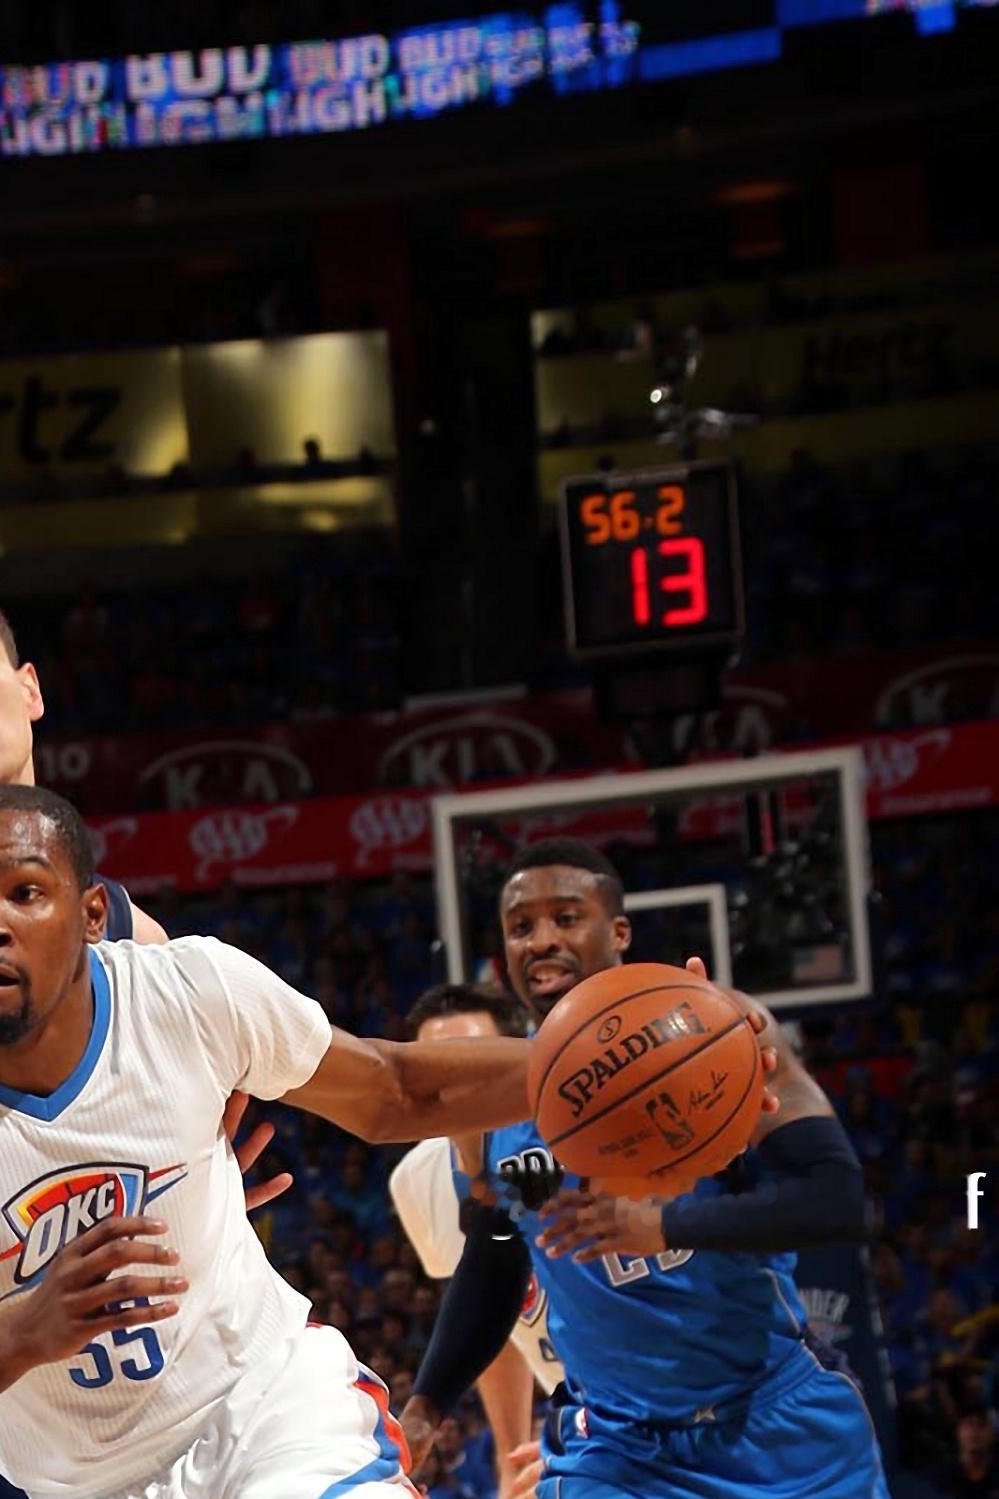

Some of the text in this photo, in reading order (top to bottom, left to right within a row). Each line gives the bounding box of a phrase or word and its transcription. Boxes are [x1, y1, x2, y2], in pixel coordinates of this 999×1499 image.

[580, 484, 685, 546] 56.2
[631, 536, 708, 626] 13
[163, 758, 281, 812] KA
[557, 1001, 708, 1117] SPALDING
[19, 1178, 116, 1279] OKC
